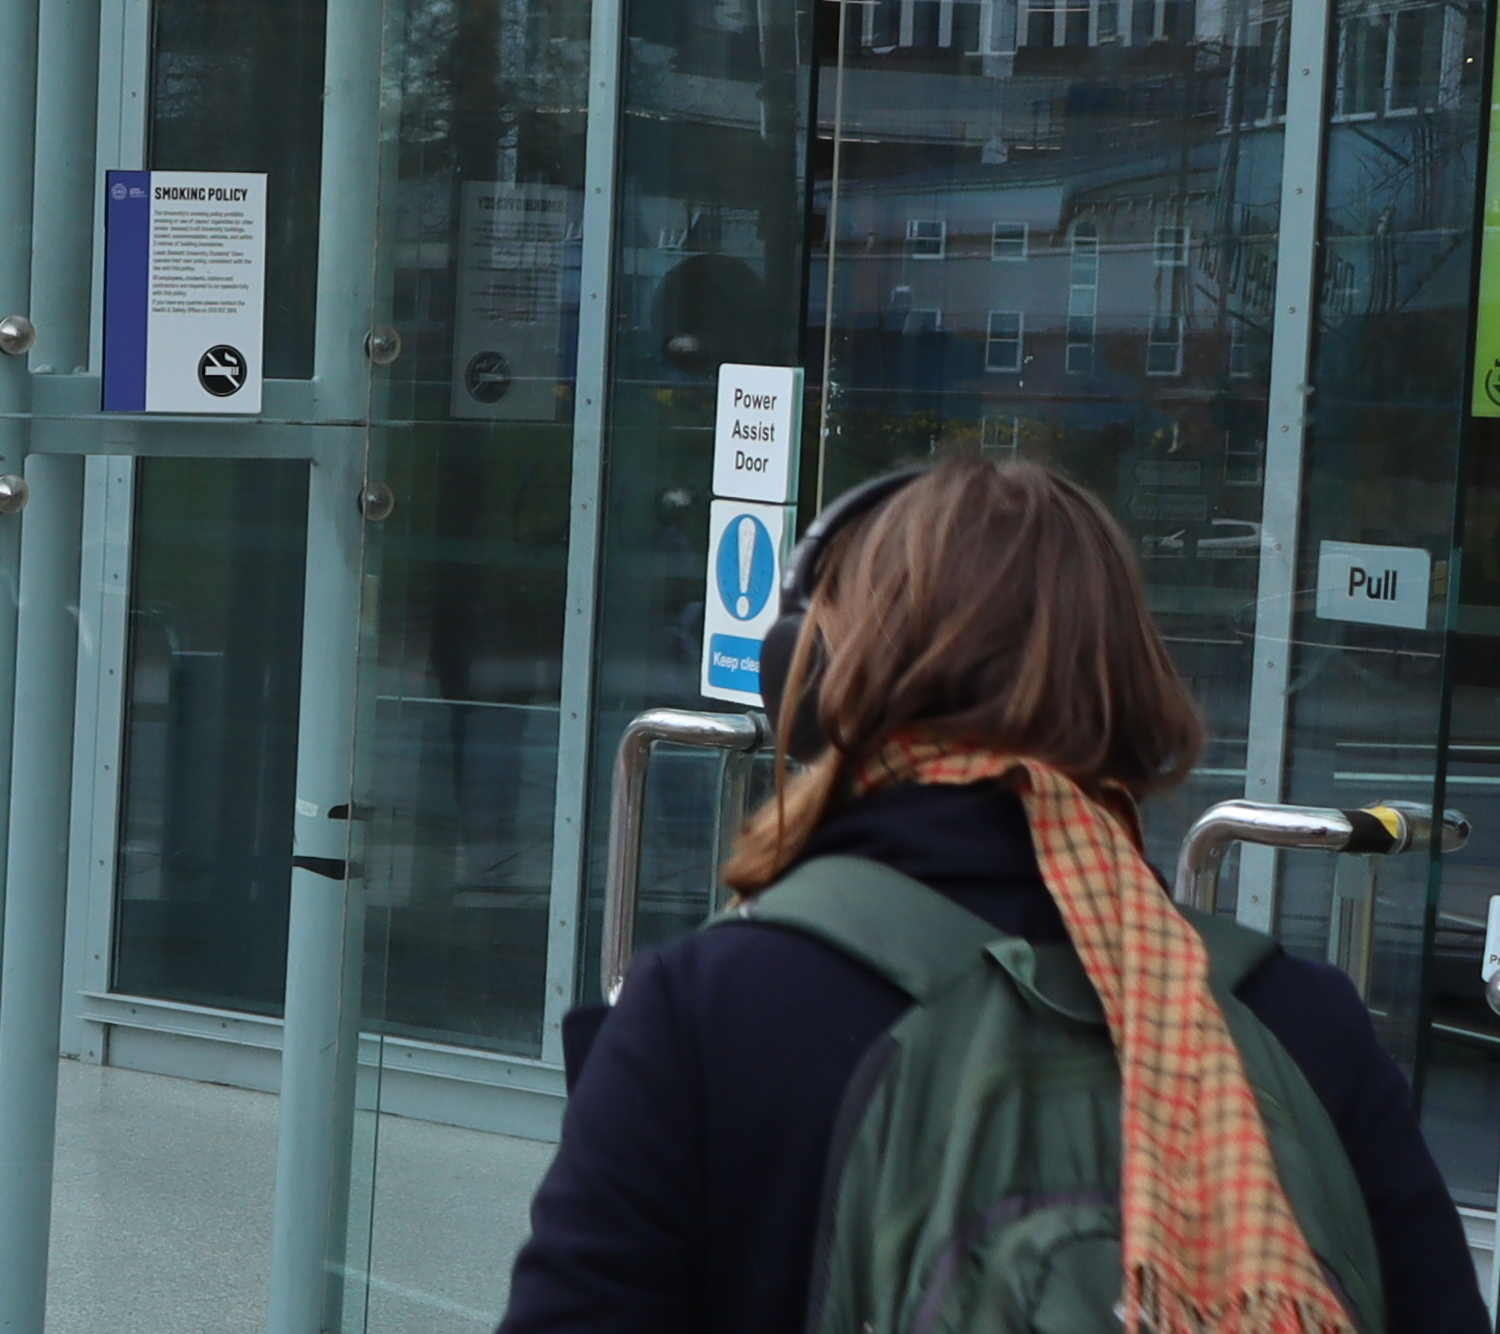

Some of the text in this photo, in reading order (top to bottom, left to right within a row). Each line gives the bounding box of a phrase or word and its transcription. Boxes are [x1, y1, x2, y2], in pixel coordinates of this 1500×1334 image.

[154, 186, 205, 201] SMOKING
[208, 187, 248, 202] POLICY
[733, 387, 778, 411] Power
[731, 419, 776, 442] Assist
[734, 450, 770, 473] Door
[1347, 565, 1398, 602] Pull
[712, 651, 761, 674] Keep clea
